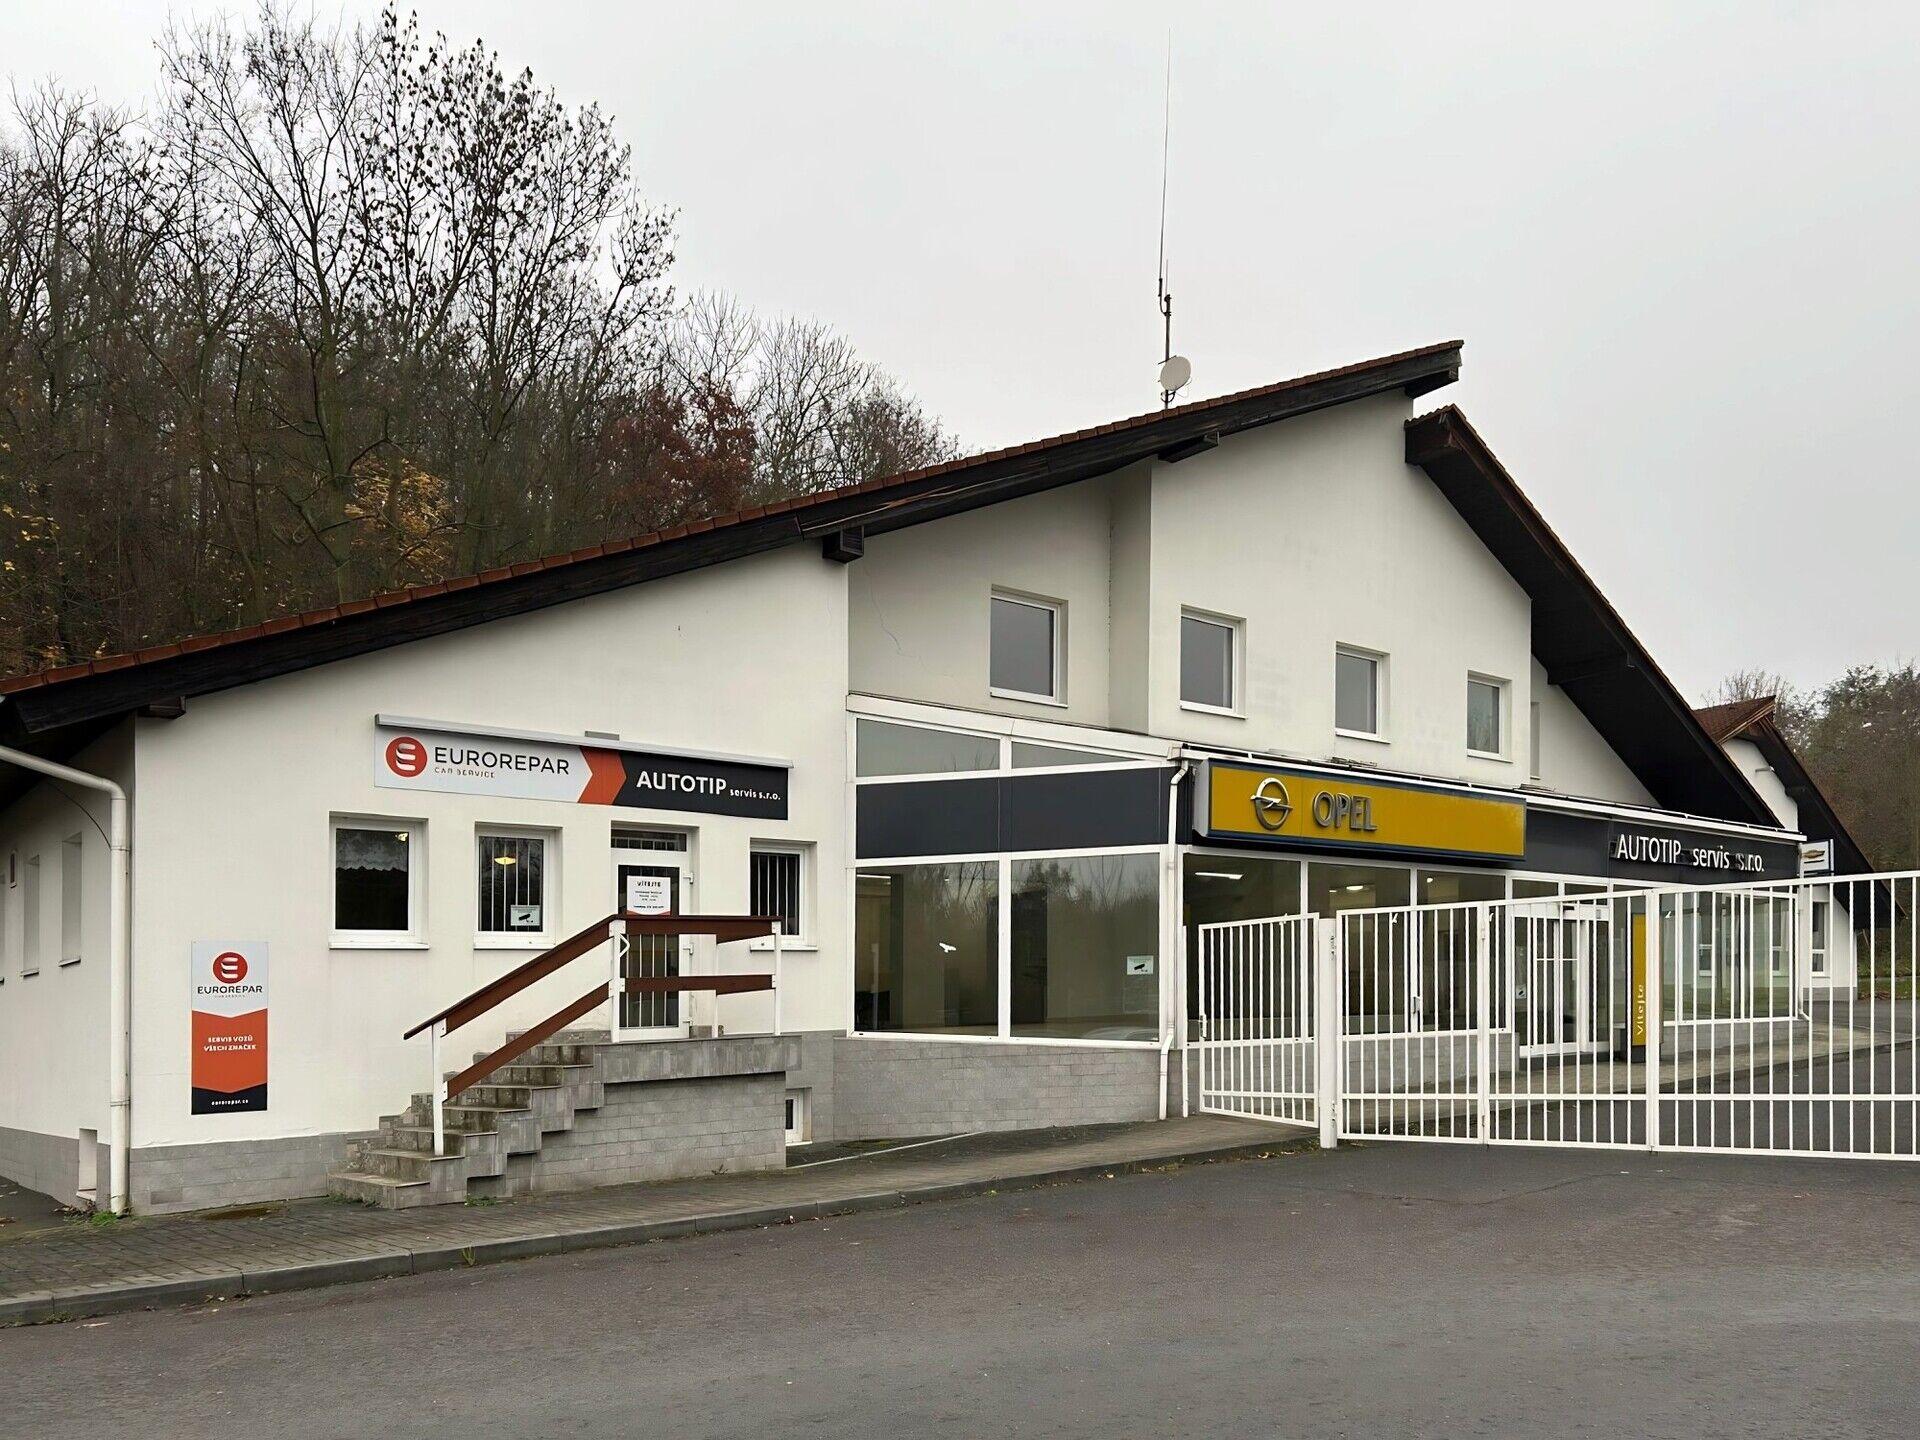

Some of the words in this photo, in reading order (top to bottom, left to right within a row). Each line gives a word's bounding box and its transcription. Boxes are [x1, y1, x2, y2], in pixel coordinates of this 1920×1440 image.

[434, 746, 570, 775] EUROREPAR
[636, 770, 727, 795] AUTOTIP
[730, 788, 757, 798] servis
[758, 791, 781, 801] s.r.o.
[1312, 790, 1378, 832] OPEL
[1616, 833, 1682, 864] AUTOTIP
[1692, 845, 1730, 869] servis
[1735, 852, 1765, 872] s.r.o.
[197, 985, 263, 995] EUROREPAR
